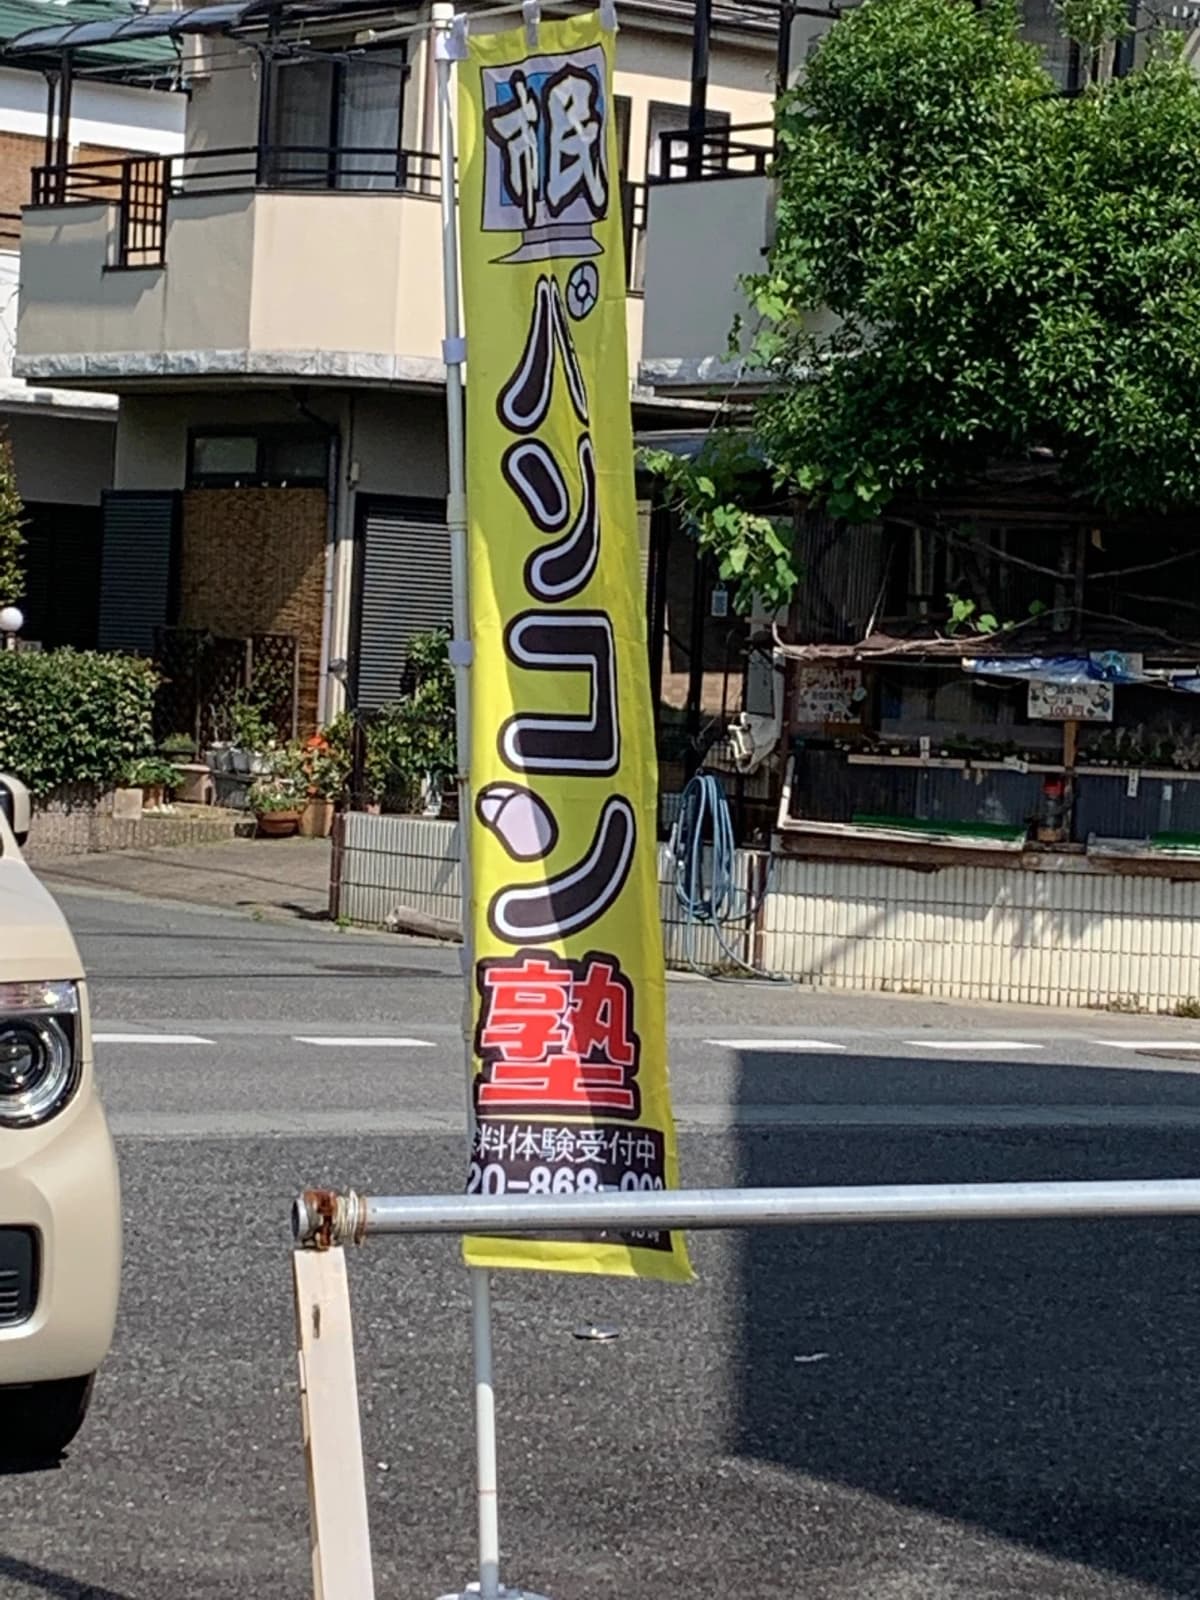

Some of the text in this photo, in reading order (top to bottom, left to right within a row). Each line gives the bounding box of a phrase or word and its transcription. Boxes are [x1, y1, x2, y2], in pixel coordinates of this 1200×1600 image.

[472, 1123, 656, 1169] 料体験受付中
